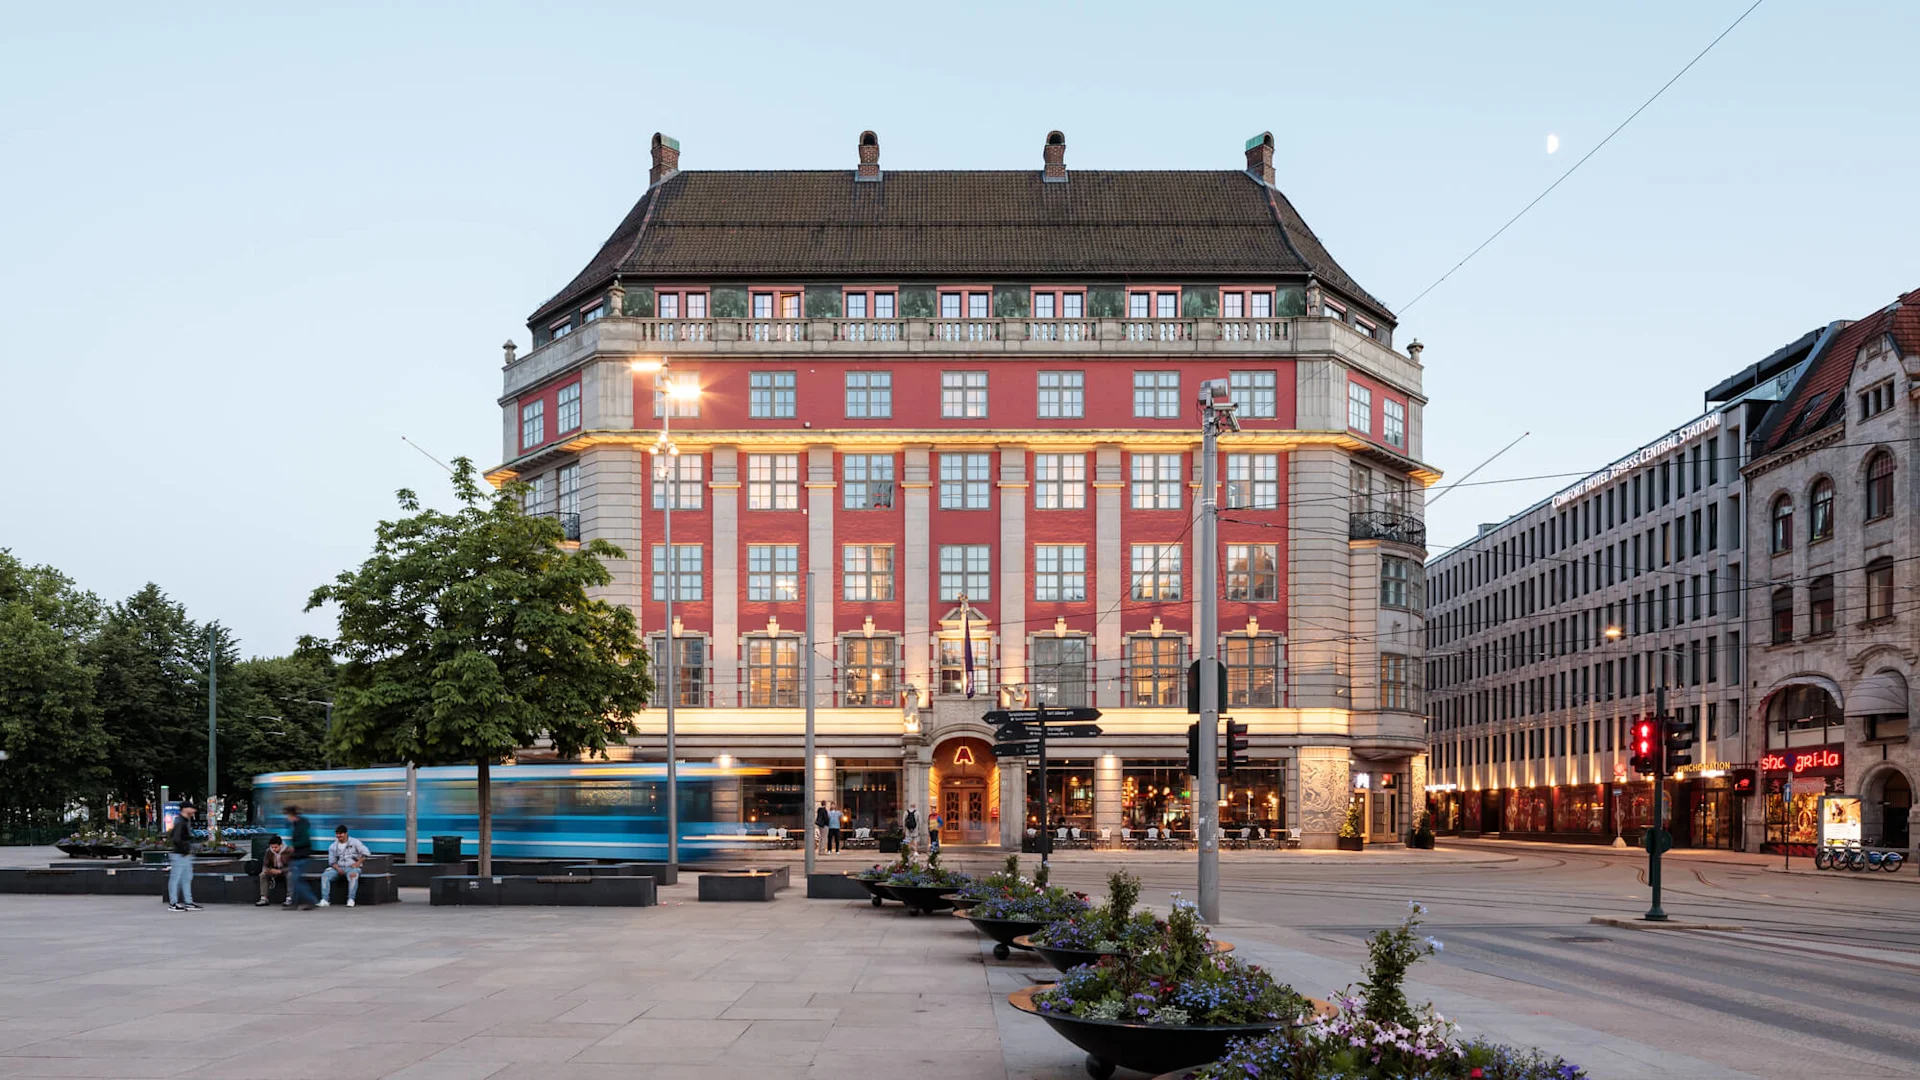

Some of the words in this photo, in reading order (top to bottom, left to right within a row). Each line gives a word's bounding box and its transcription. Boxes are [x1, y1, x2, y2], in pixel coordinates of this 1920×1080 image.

[1552, 484, 1585, 508] COMFORT
[1585, 471, 1609, 492] HOTEL
[1640, 434, 1678, 463] CENTRAL
[1680, 412, 1720, 443] STATION
[953, 746, 974, 764] A
